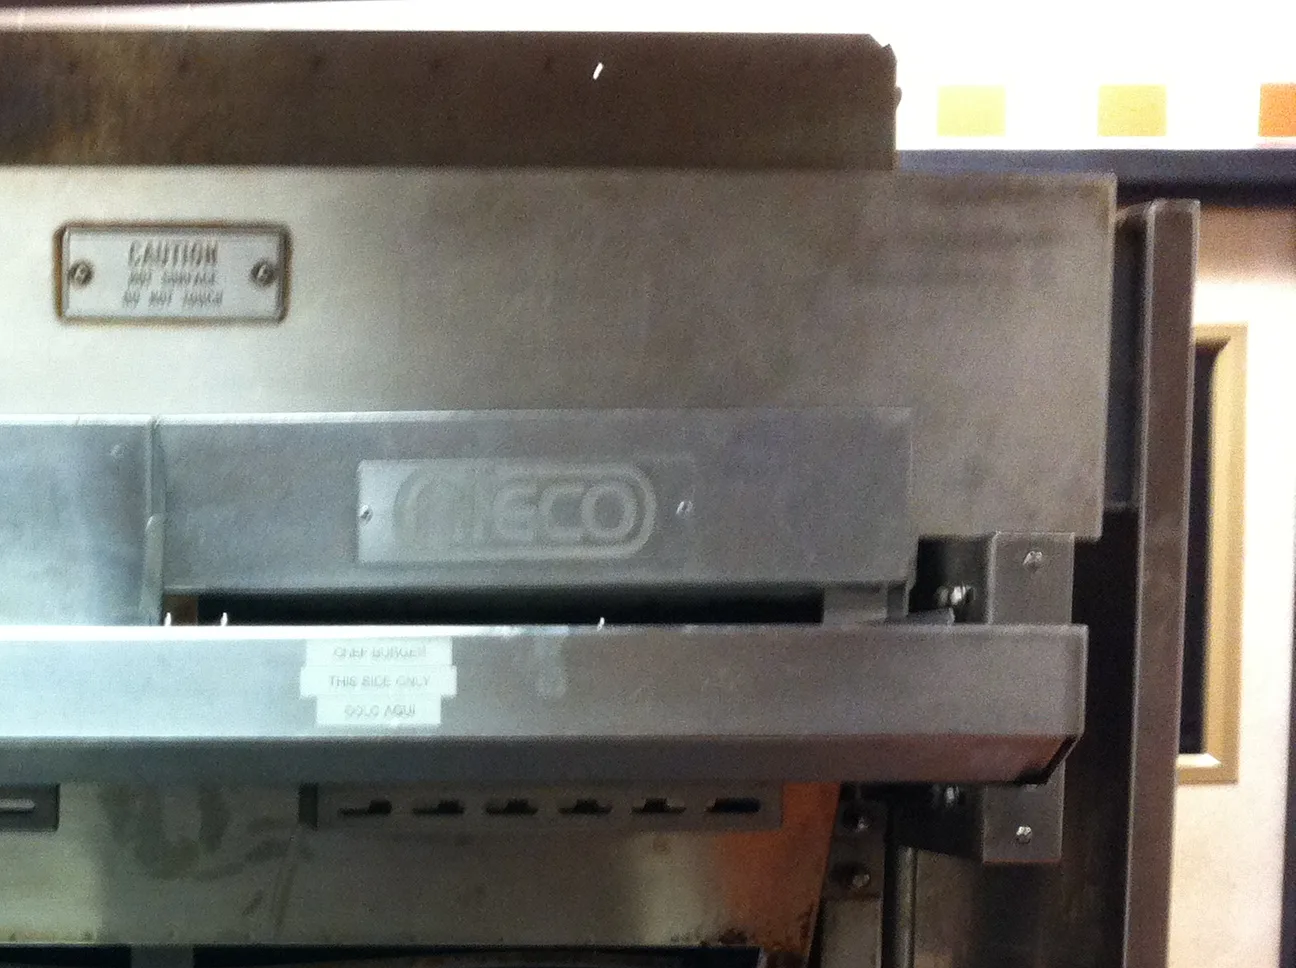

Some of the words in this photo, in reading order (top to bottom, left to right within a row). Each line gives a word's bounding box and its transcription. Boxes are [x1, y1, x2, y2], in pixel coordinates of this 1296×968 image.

[127, 240, 218, 266] CAUTION
[329, 675, 358, 688] THIS
[395, 674, 431, 687] ONLY
